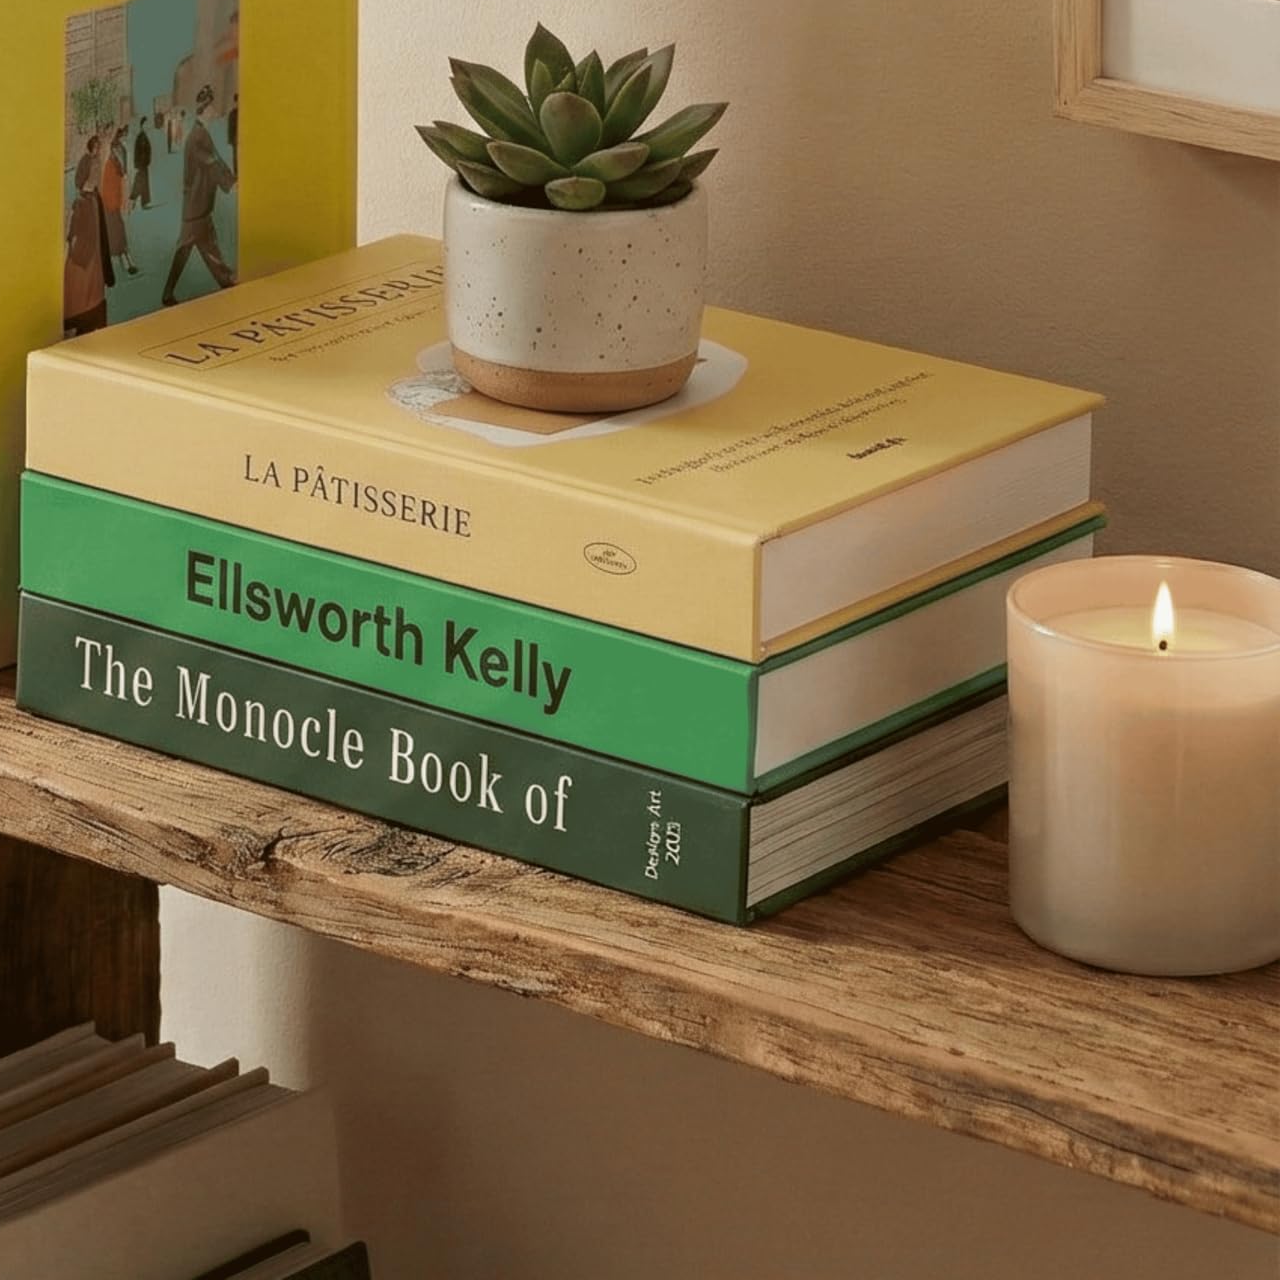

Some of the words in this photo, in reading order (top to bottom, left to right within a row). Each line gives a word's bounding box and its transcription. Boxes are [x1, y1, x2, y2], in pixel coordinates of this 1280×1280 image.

[166, 341, 240, 365] LA
[244, 454, 281, 488] LA
[292, 465, 472, 539] PÂTISSERIE
[185, 550, 423, 665] Ellsworth
[444, 620, 573, 716] Kelly
[74, 636, 154, 707] The
[176, 665, 365, 770] Monocle
[388, 727, 504, 814] Book
[524, 775, 573, 832] of
[646, 790, 662, 817] Art
